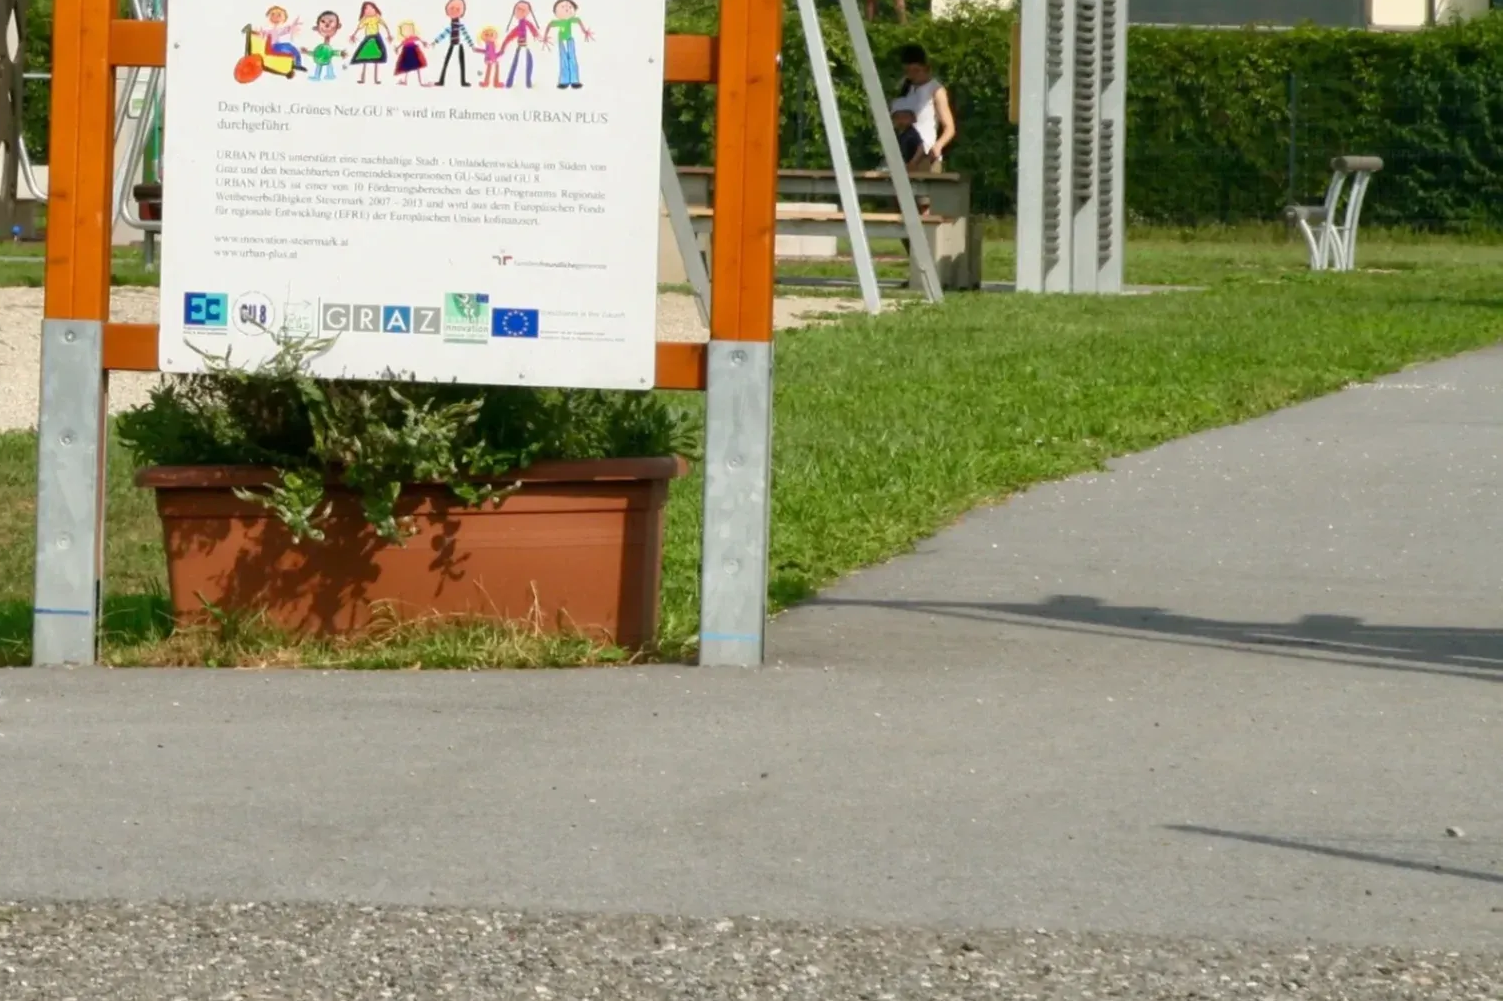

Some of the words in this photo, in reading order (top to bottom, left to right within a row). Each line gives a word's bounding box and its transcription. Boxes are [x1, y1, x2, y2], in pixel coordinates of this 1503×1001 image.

[217, 100, 239, 113] Das
[243, 101, 281, 116] Projekt
[334, 104, 360, 117] Netz
[362, 105, 382, 117] GU
[402, 107, 428, 118] wird
[431, 108, 446, 119] im
[449, 108, 496, 121] Rahmen
[499, 112, 519, 122] von
[523, 110, 571, 123] URBAN
[575, 112, 608, 124] PLUS
[216, 150, 256, 161] URBAN
[259, 151, 286, 162] PLUS
[415, 156, 439, 166] Stadt
[559, 160, 587, 171] Süden
[216, 164, 238, 174] Graz
[241, 165, 258, 175] und
[261, 165, 277, 175] den
[215, 178, 255, 188] URBAN
[259, 178, 286, 189] PLUS
[368, 196, 390, 206] 2007
[402, 198, 423, 209] 2013
[426, 199, 444, 209] und
[490, 201, 510, 211] dem
[372, 210, 387, 221] der
[453, 212, 481, 224] Union
[259, 304, 267, 324] 8
[326, 306, 435, 332] GRAZ
